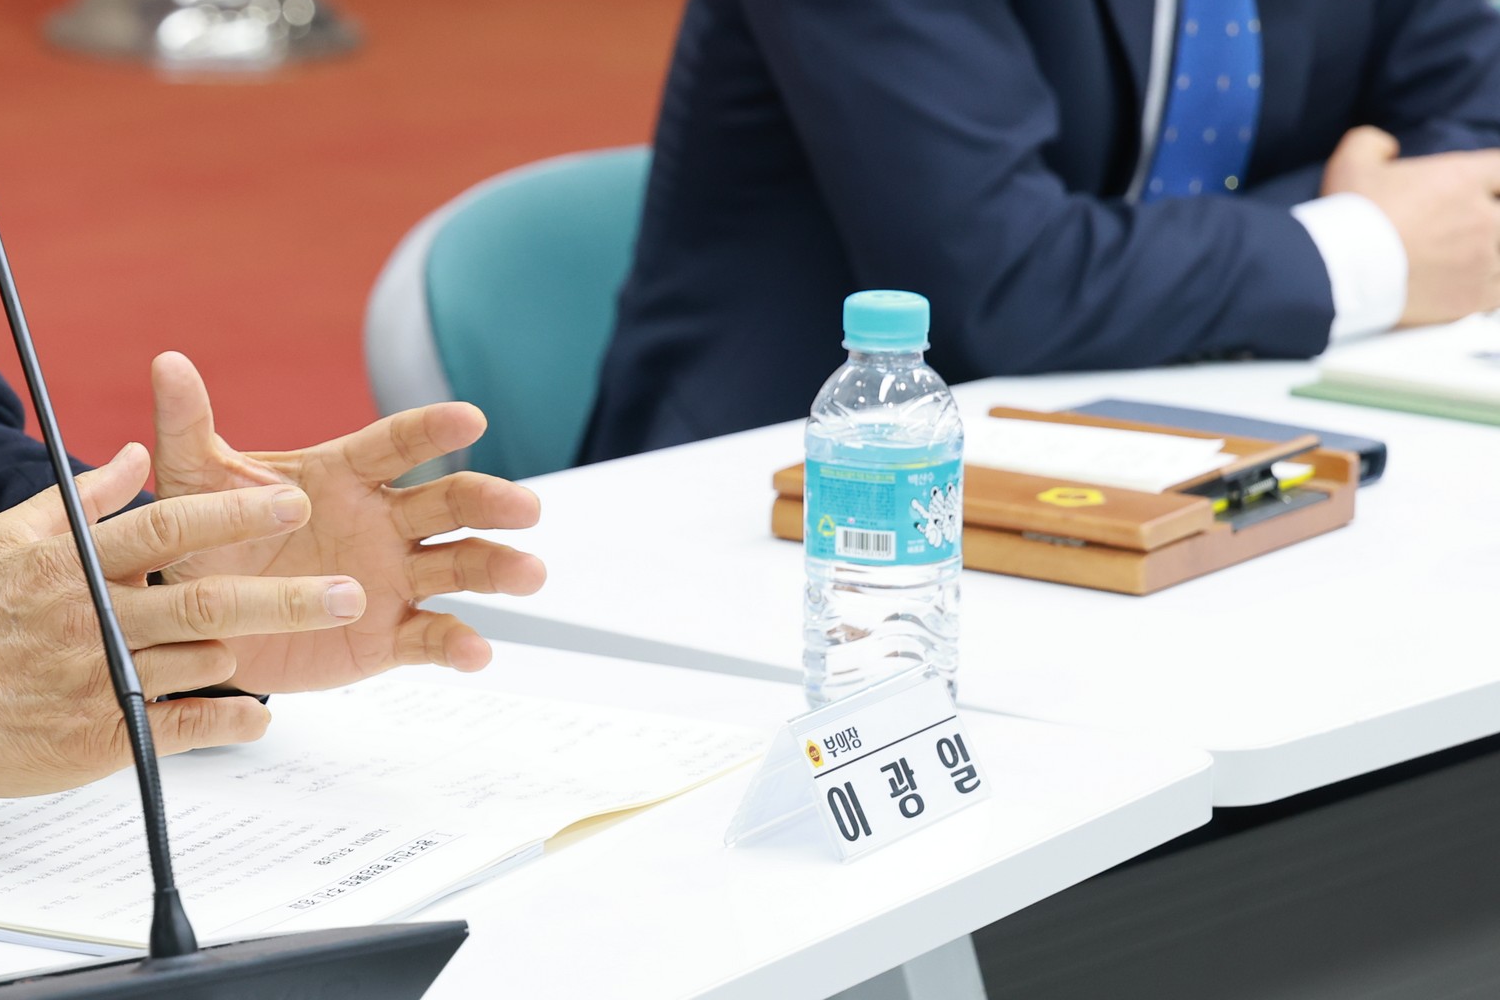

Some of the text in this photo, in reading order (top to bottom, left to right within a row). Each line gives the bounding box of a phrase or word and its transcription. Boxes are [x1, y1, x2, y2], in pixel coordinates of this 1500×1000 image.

[822, 726, 862, 758] 부의장
[827, 733, 981, 842] 이 광 일
